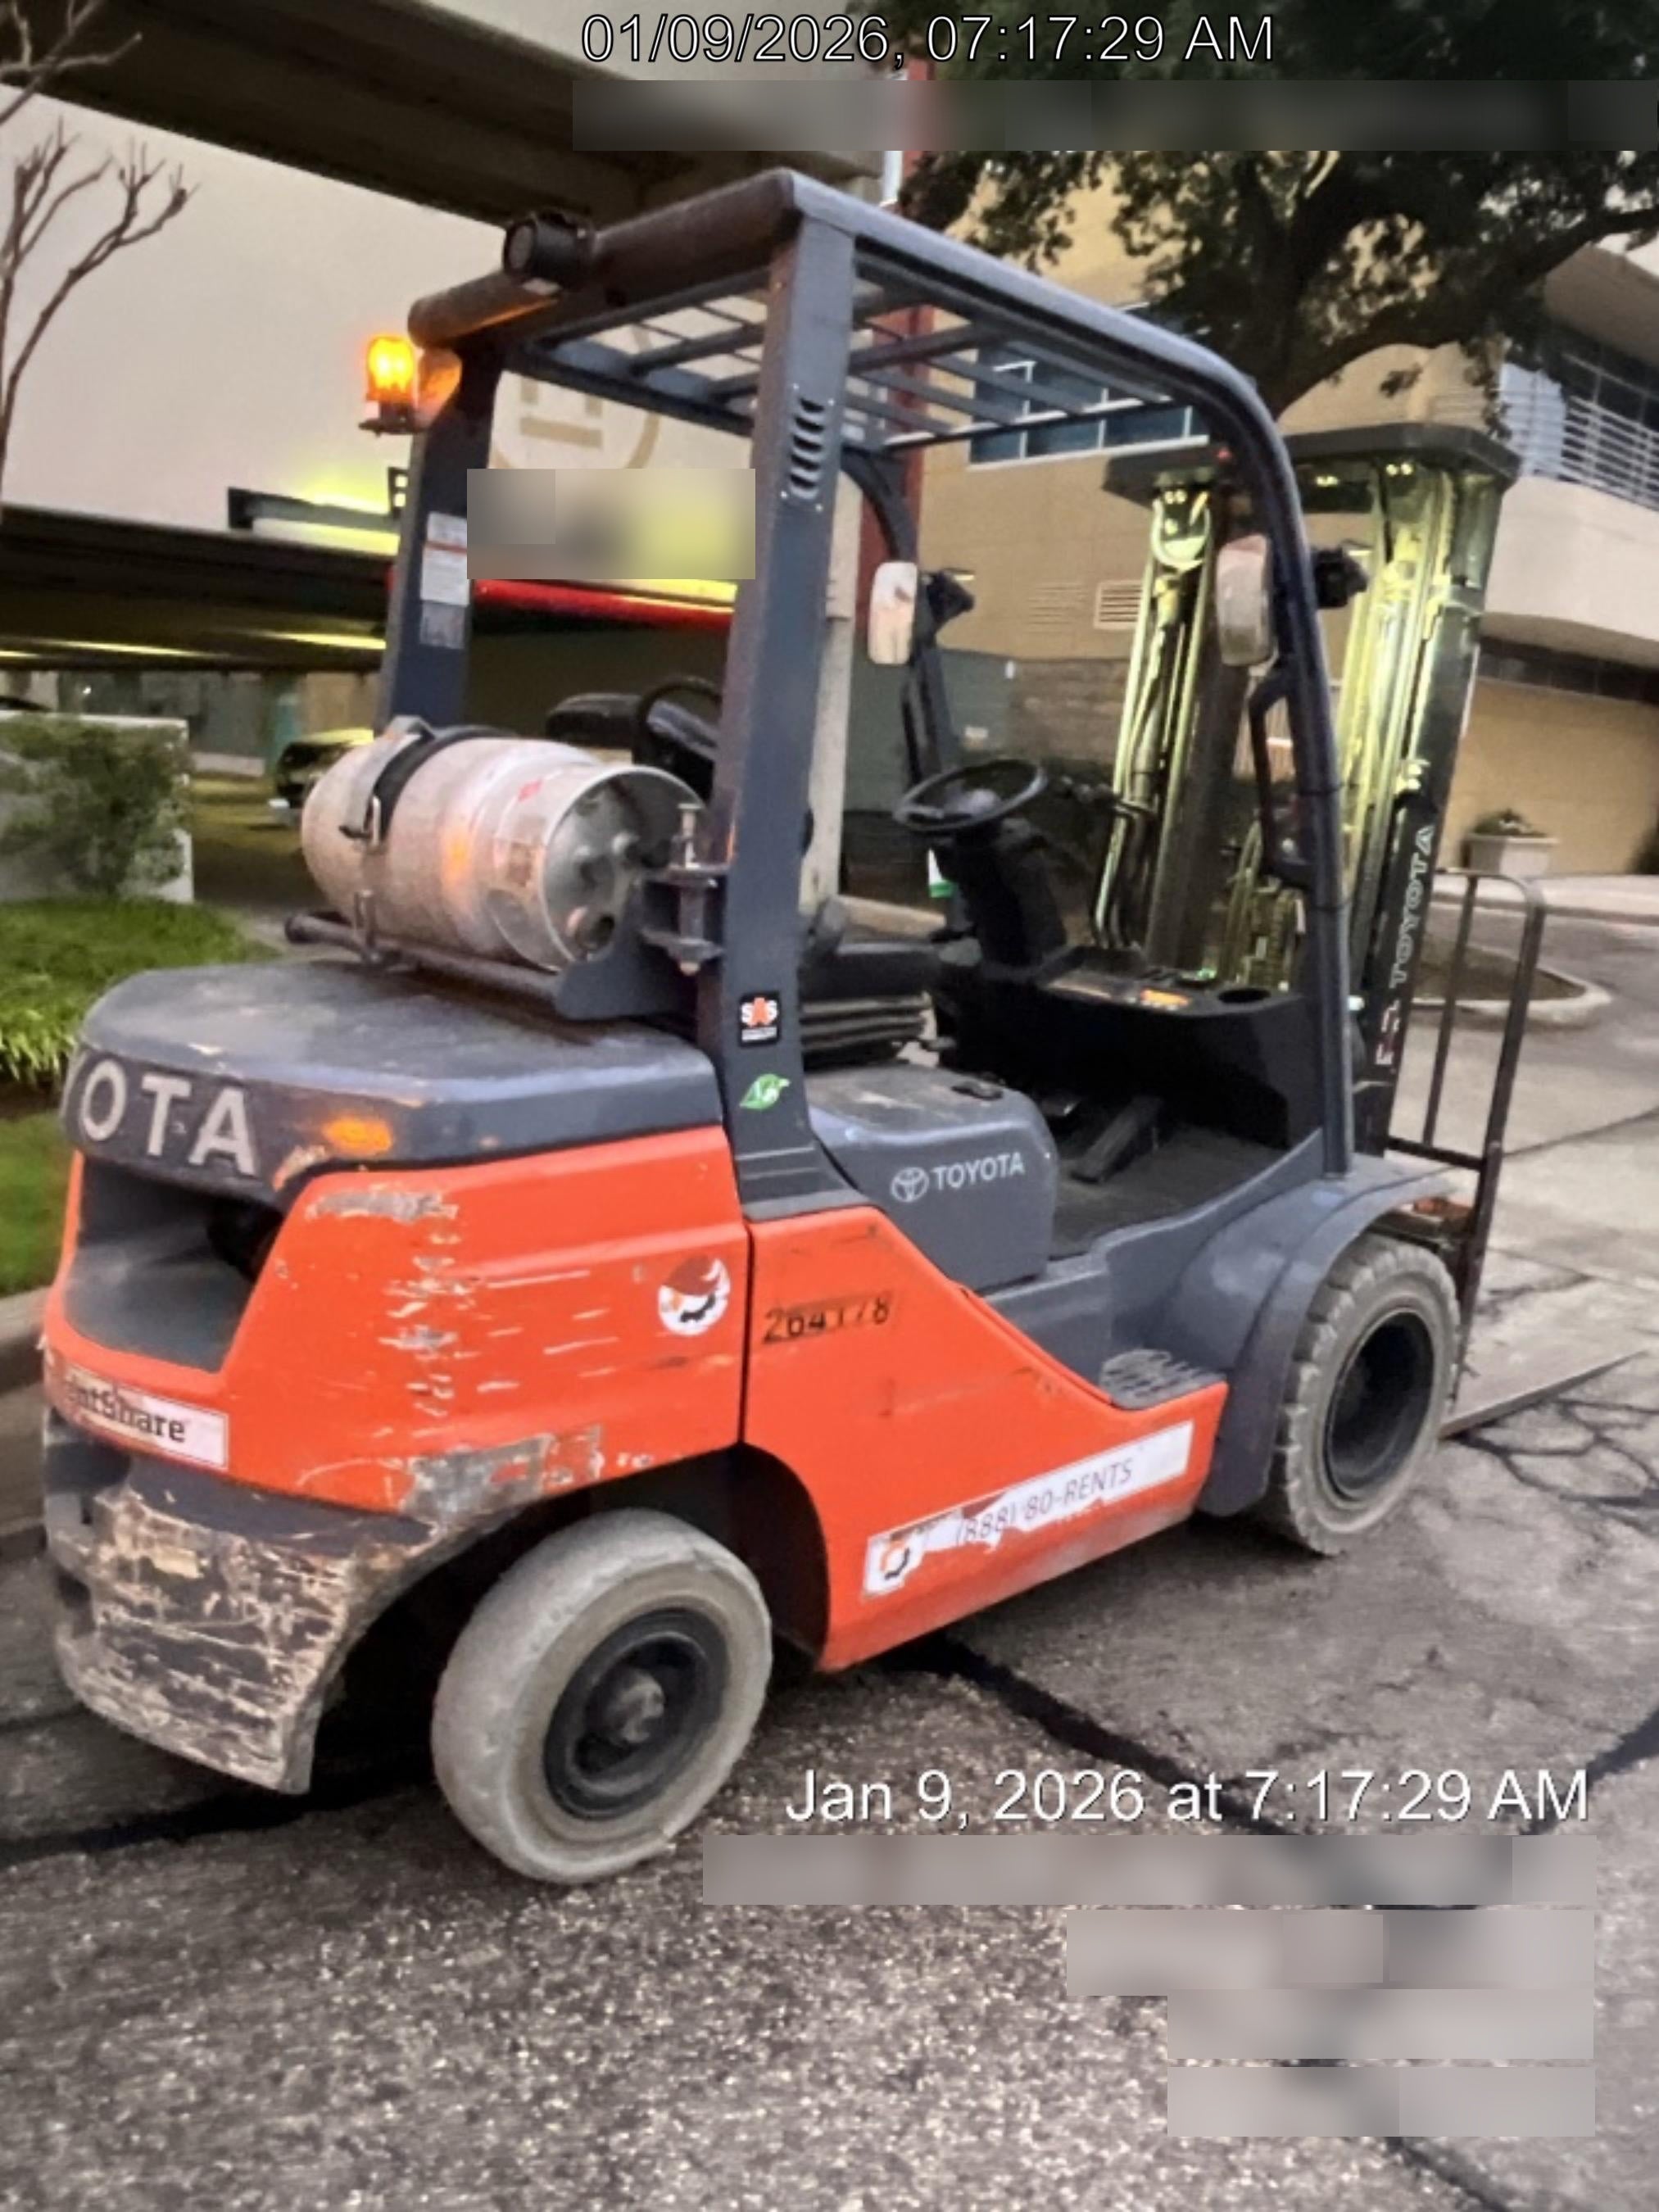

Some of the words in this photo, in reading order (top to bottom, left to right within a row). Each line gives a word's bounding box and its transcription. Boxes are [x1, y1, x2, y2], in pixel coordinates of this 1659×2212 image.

[1389, 824, 1435, 988] TOYOTA
[930, 1151, 1026, 1191] TOYOTA
[1023, 1457, 1135, 1521] 80-RENTS
